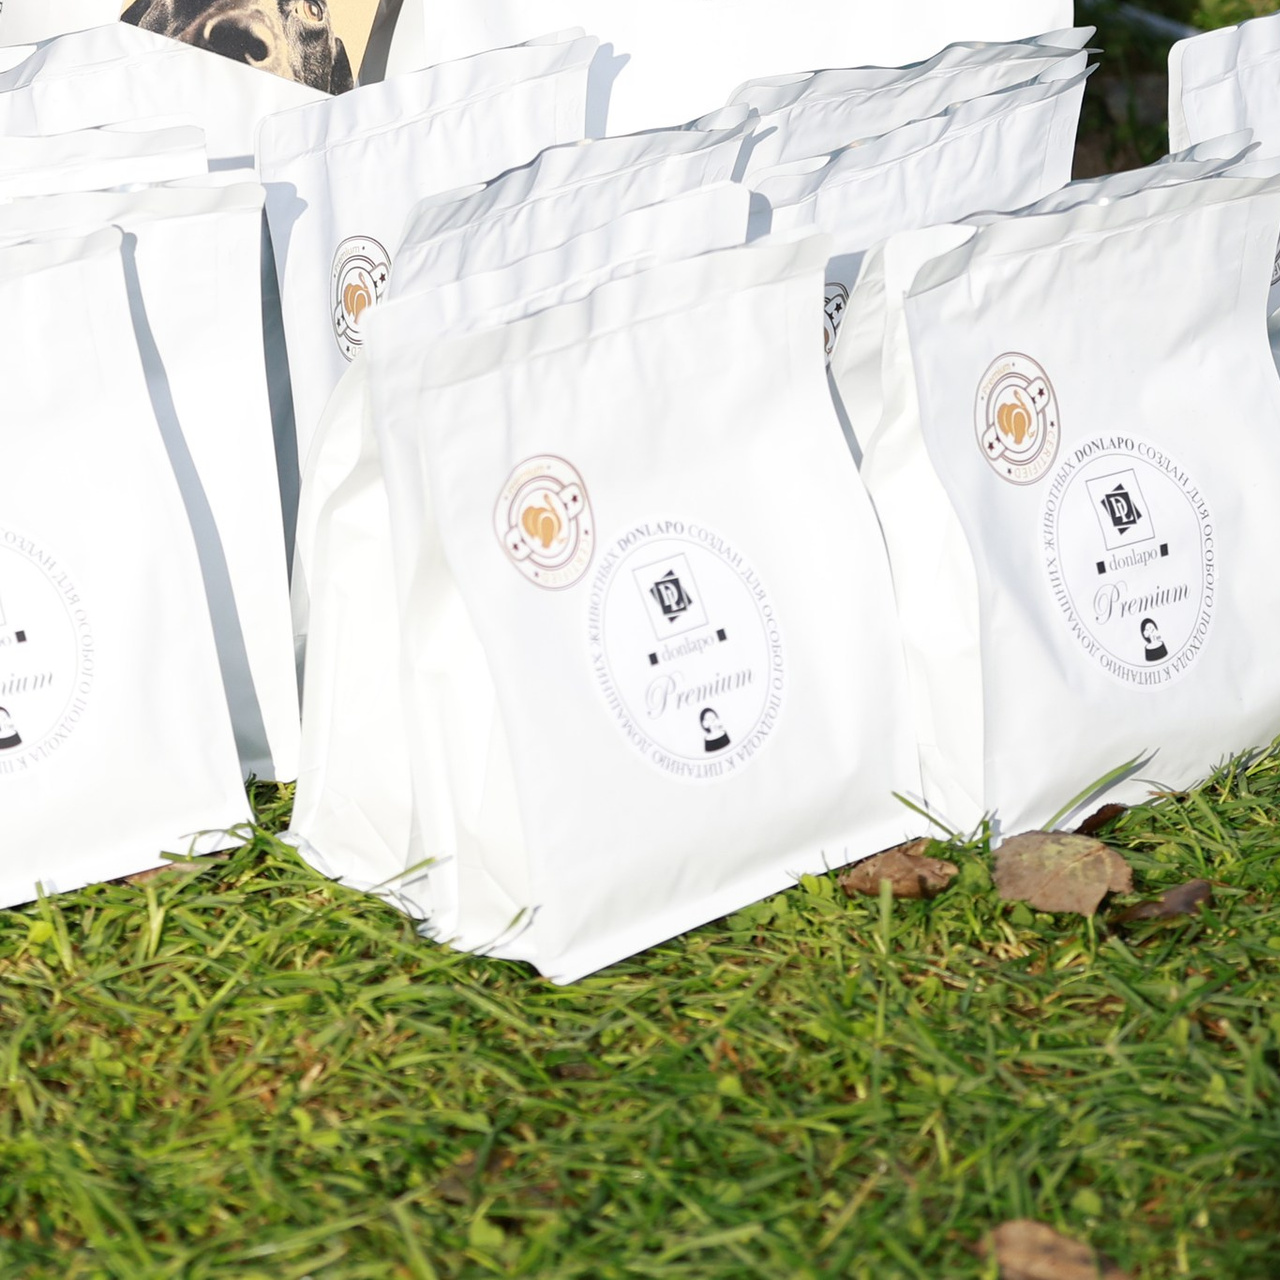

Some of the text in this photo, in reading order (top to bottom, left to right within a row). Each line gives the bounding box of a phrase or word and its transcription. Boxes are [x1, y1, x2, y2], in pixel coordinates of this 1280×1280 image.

[1044, 436, 1215, 686] DONLAPO СОЗДАН ДЛЯ ОСОБОГО ПОДХОДА ПИТАНИЮ ДОМАШНИХ ЖИВОТНЫХ
[1108, 548, 1158, 573] donlapo
[1094, 580, 1191, 625] Premium
[660, 634, 715, 663] donlapo
[645, 667, 754, 720] Premium
